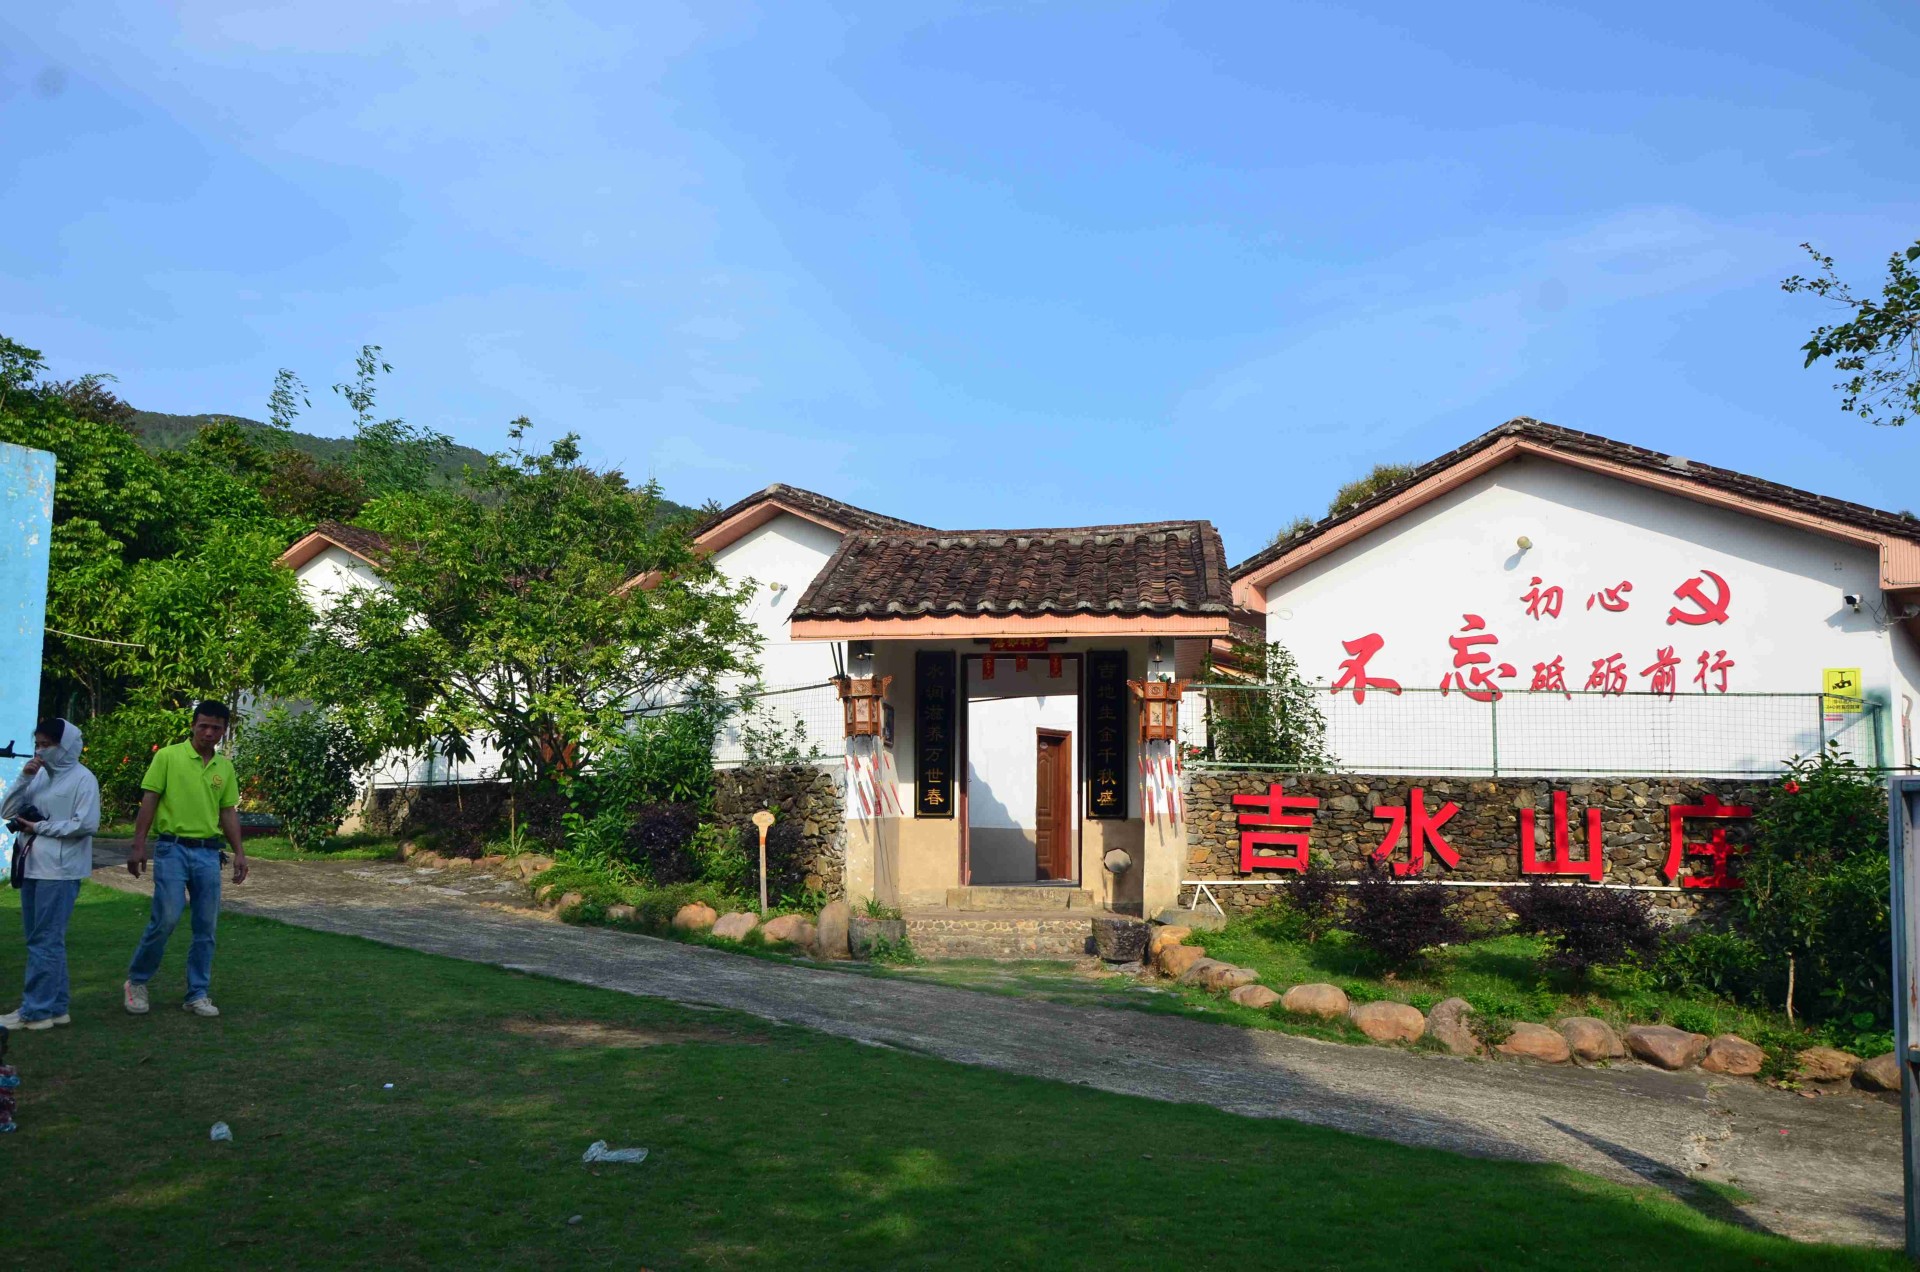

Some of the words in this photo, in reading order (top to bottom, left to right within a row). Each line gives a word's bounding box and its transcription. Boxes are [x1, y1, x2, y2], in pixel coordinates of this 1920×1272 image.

[1520, 576, 1634, 621] 初心
[1331, 614, 1516, 704] 不忘
[1529, 645, 1736, 702] 砥砺前行
[1096, 662, 1118, 807] 吉地生金千秋盛
[1232, 783, 1753, 889] 吉水山庄
